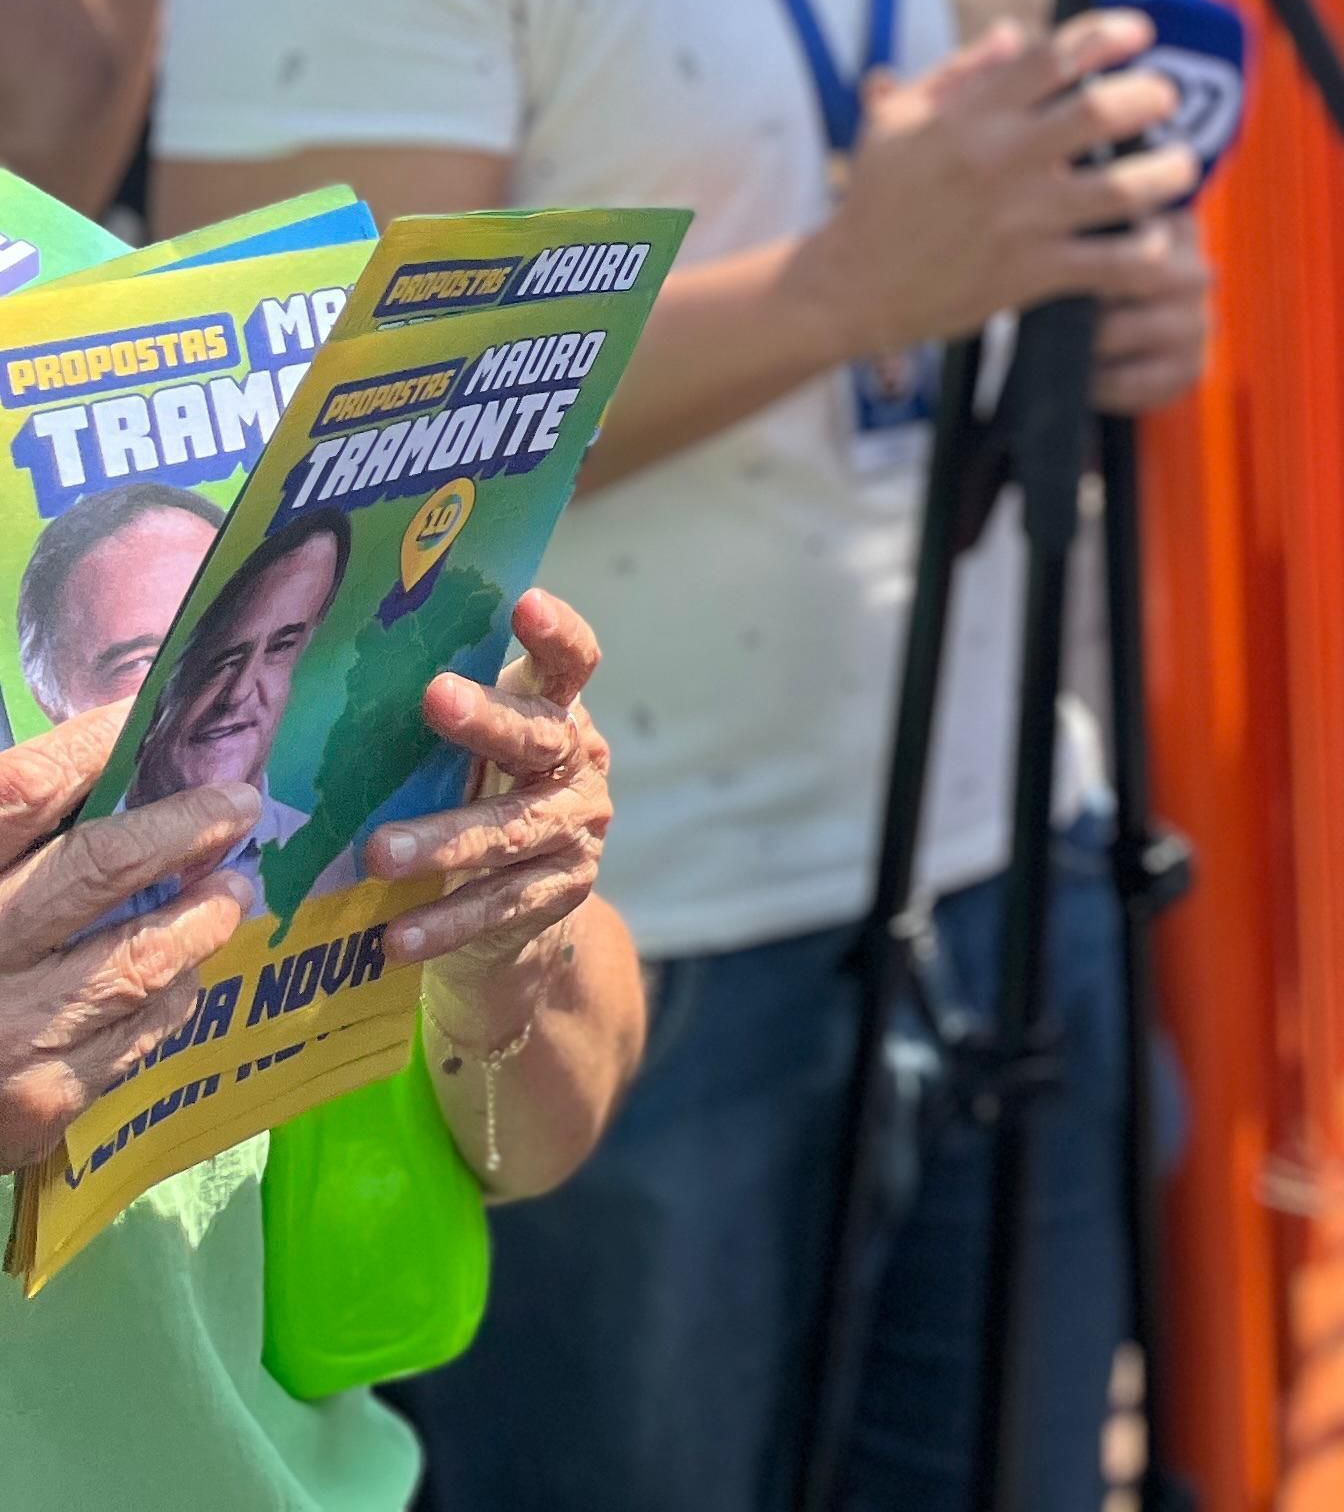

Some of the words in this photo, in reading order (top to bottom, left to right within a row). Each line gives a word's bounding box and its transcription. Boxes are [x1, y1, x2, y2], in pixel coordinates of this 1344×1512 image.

[385, 265, 511, 307] PROPOSTAS
[516, 242, 651, 297] MAURO
[6, 324, 229, 397] PROPOSTAS
[321, 368, 456, 426] PROPOSTAS
[463, 329, 608, 397] MAURO
[33, 362, 313, 488] TRAM
[291, 387, 581, 510] TRAMONTE
[416, 501, 458, 542] 10
[245, 922, 389, 1029] NOVA
